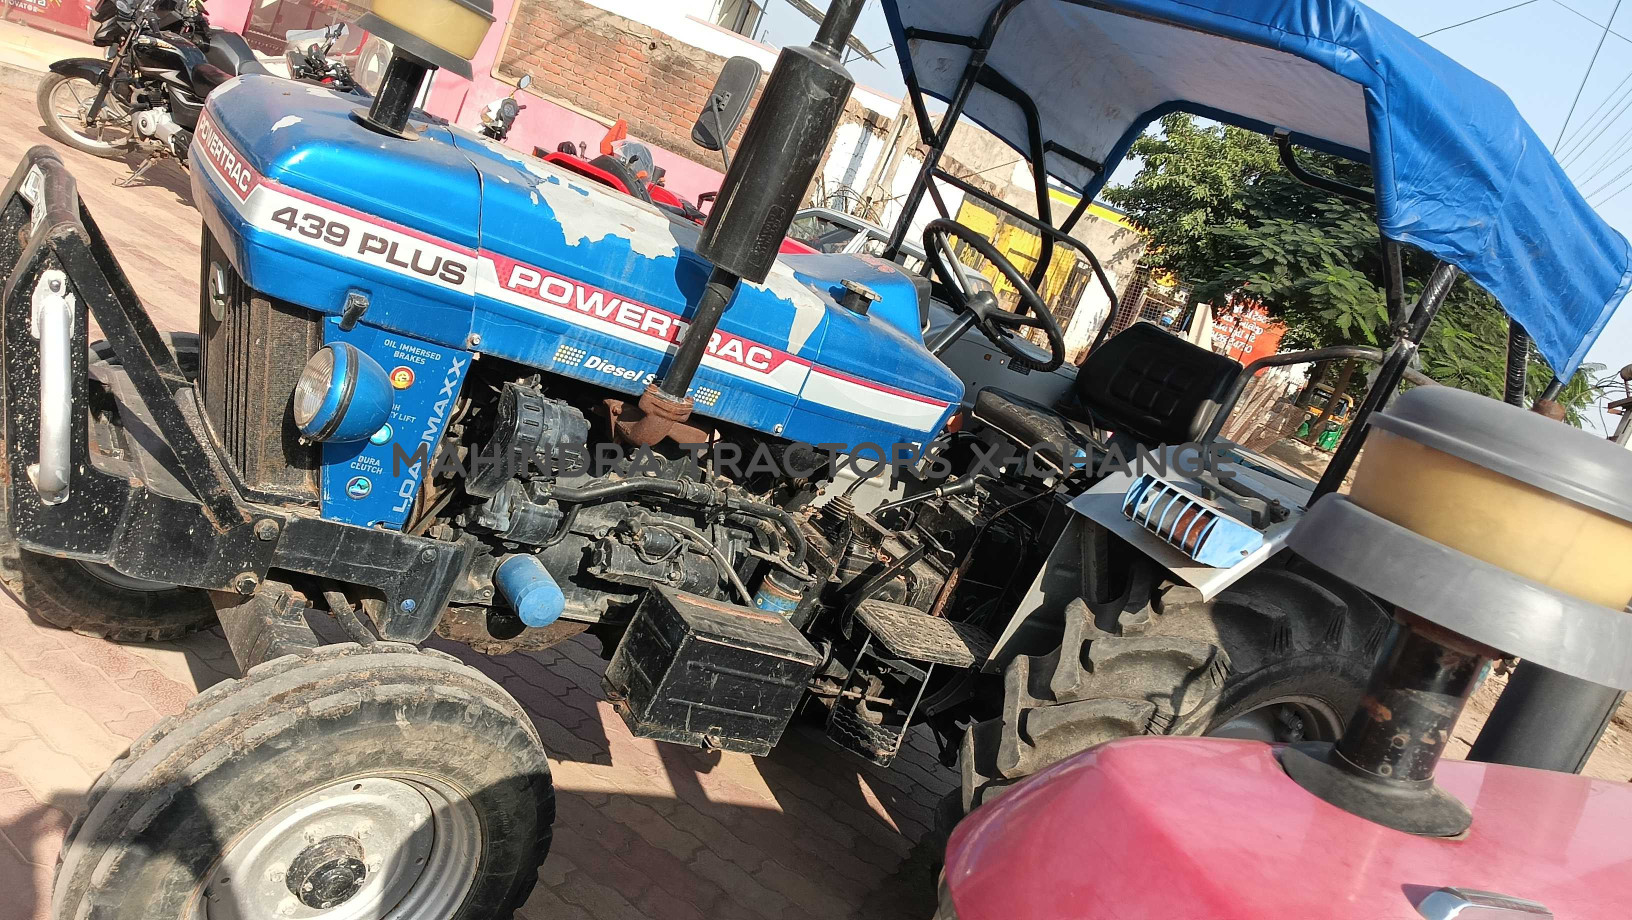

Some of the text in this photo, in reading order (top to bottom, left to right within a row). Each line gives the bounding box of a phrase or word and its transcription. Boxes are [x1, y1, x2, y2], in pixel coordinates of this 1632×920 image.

[199, 115, 251, 193] POWERTRAC
[271, 206, 467, 285] 439 PLUS
[384, 339, 441, 361] OIL IMMERSED
[393, 350, 426, 365] BRAKES
[583, 355, 646, 383] Diesel
[398, 414, 417, 423] LIFT
[350, 462, 383, 475] CLUTCH
[357, 455, 381, 467] DURA
